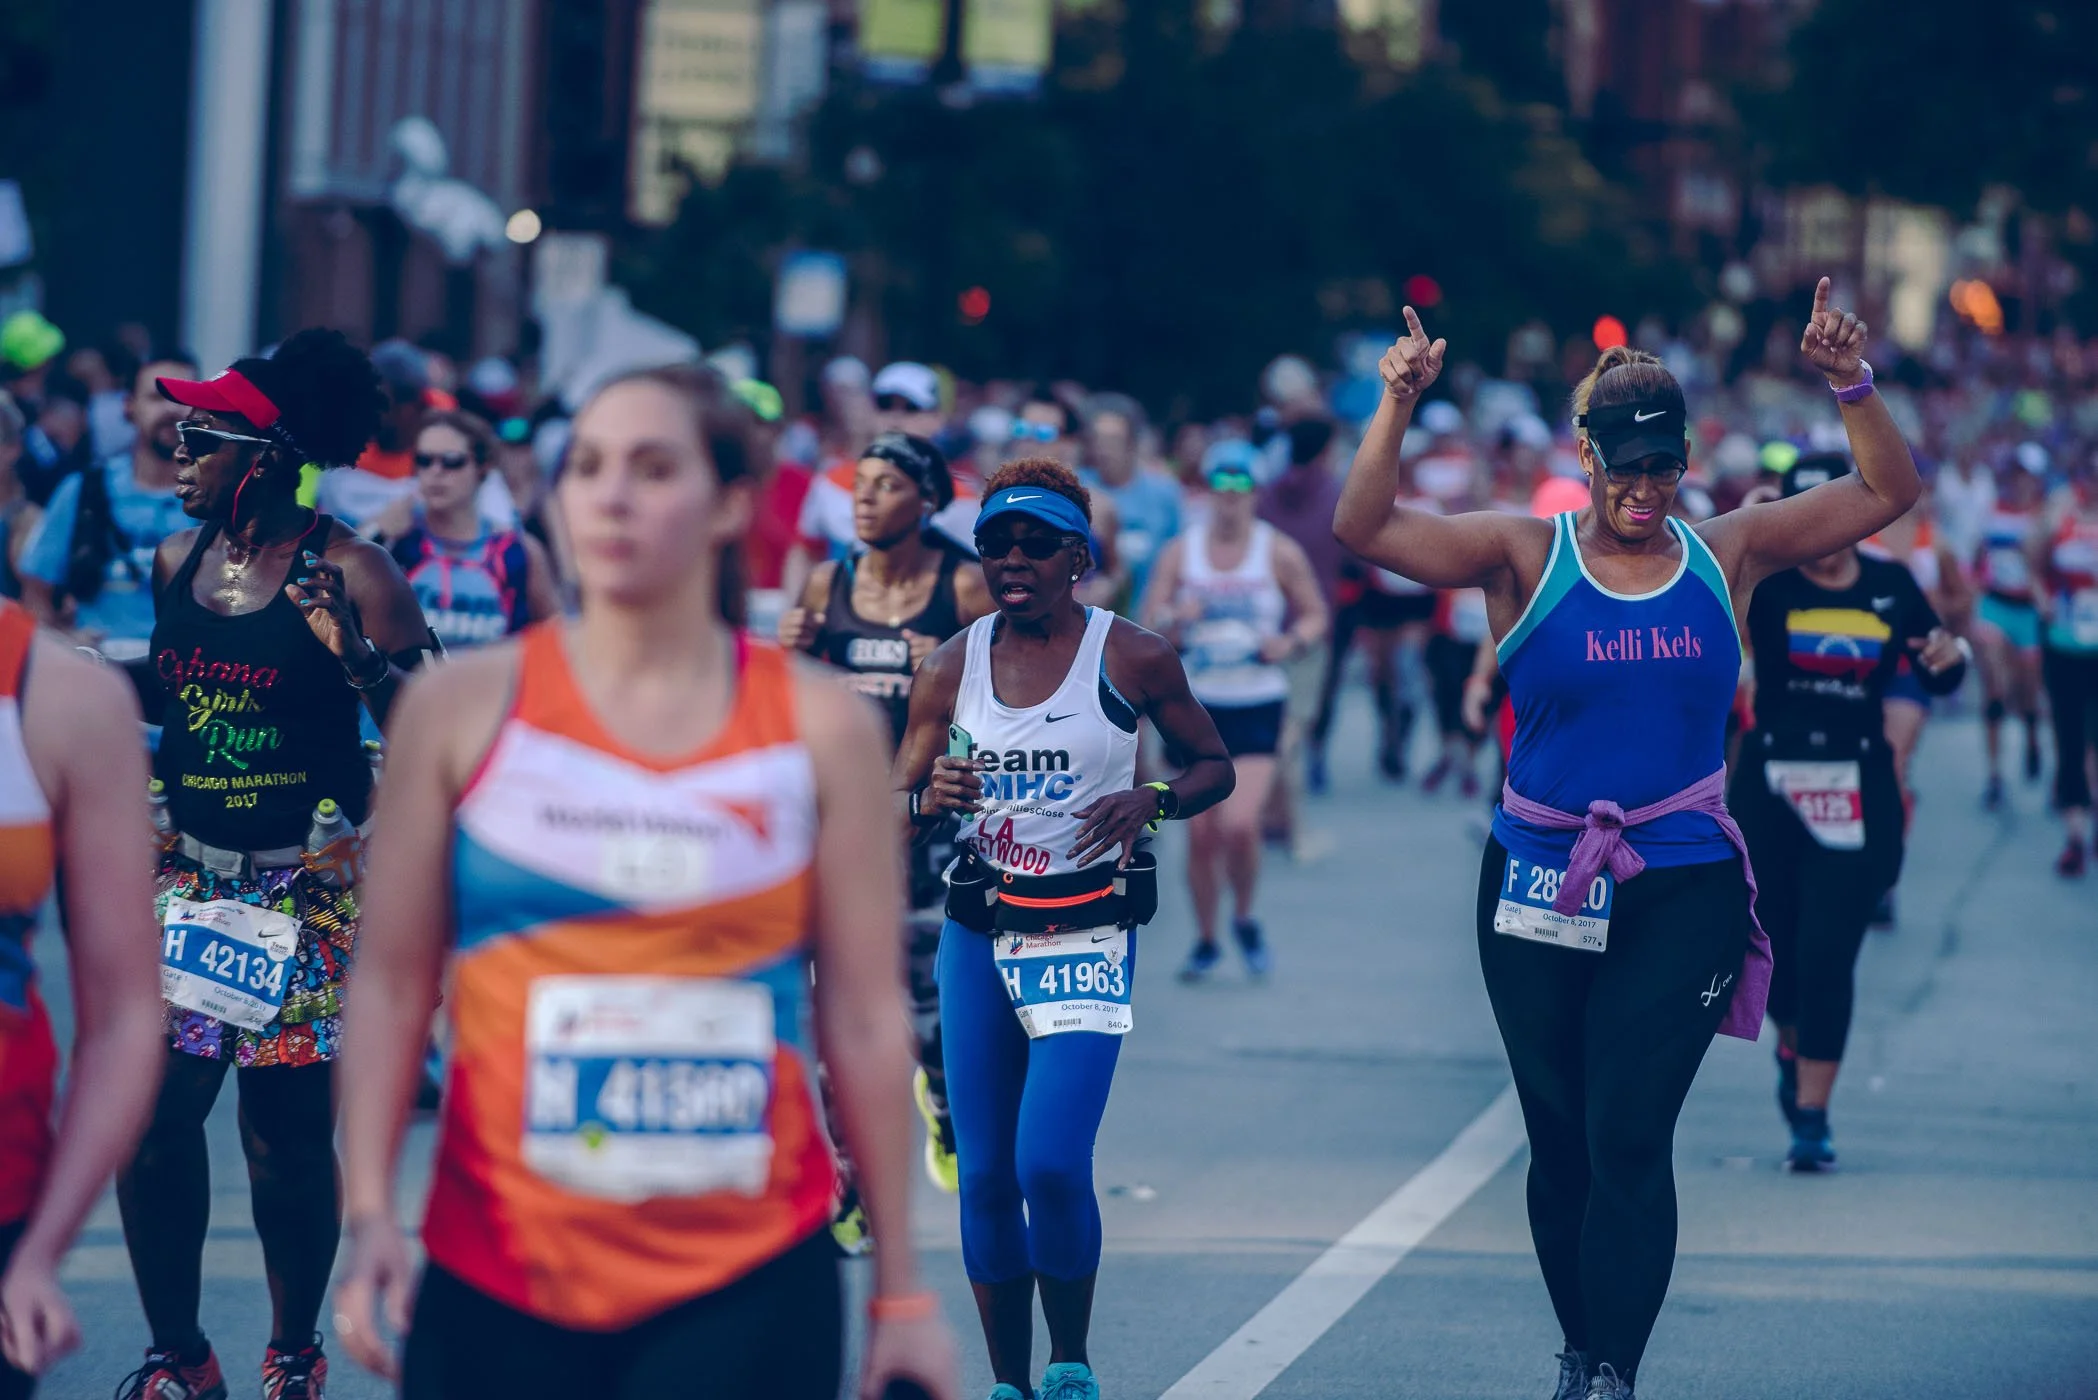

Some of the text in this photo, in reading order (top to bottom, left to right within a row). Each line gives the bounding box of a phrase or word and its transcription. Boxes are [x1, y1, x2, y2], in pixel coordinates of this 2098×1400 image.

[1585, 626, 1702, 661] Kelli Kels
[180, 684, 266, 732] Girls
[199, 719, 285, 769] Run
[182, 771, 306, 790] CHICAGO MARATHON
[982, 773, 1076, 801] MHC
[225, 792, 258, 809] 2017
[978, 816, 1014, 844] LA
[1507, 859, 1607, 911] F 280
[1542, 913, 1570, 925] October
[1578, 920, 1597, 929] 2017
[1026, 940, 1062, 949] Marathon
[1582, 935, 1597, 945] 577
[164, 930, 285, 998] H 42134
[1001, 961, 1125, 1001] H 41963
[214, 986, 244, 1002] October
[1061, 1003, 1119, 1014] October 8, 2017
[1107, 1020, 1123, 1029] 840
